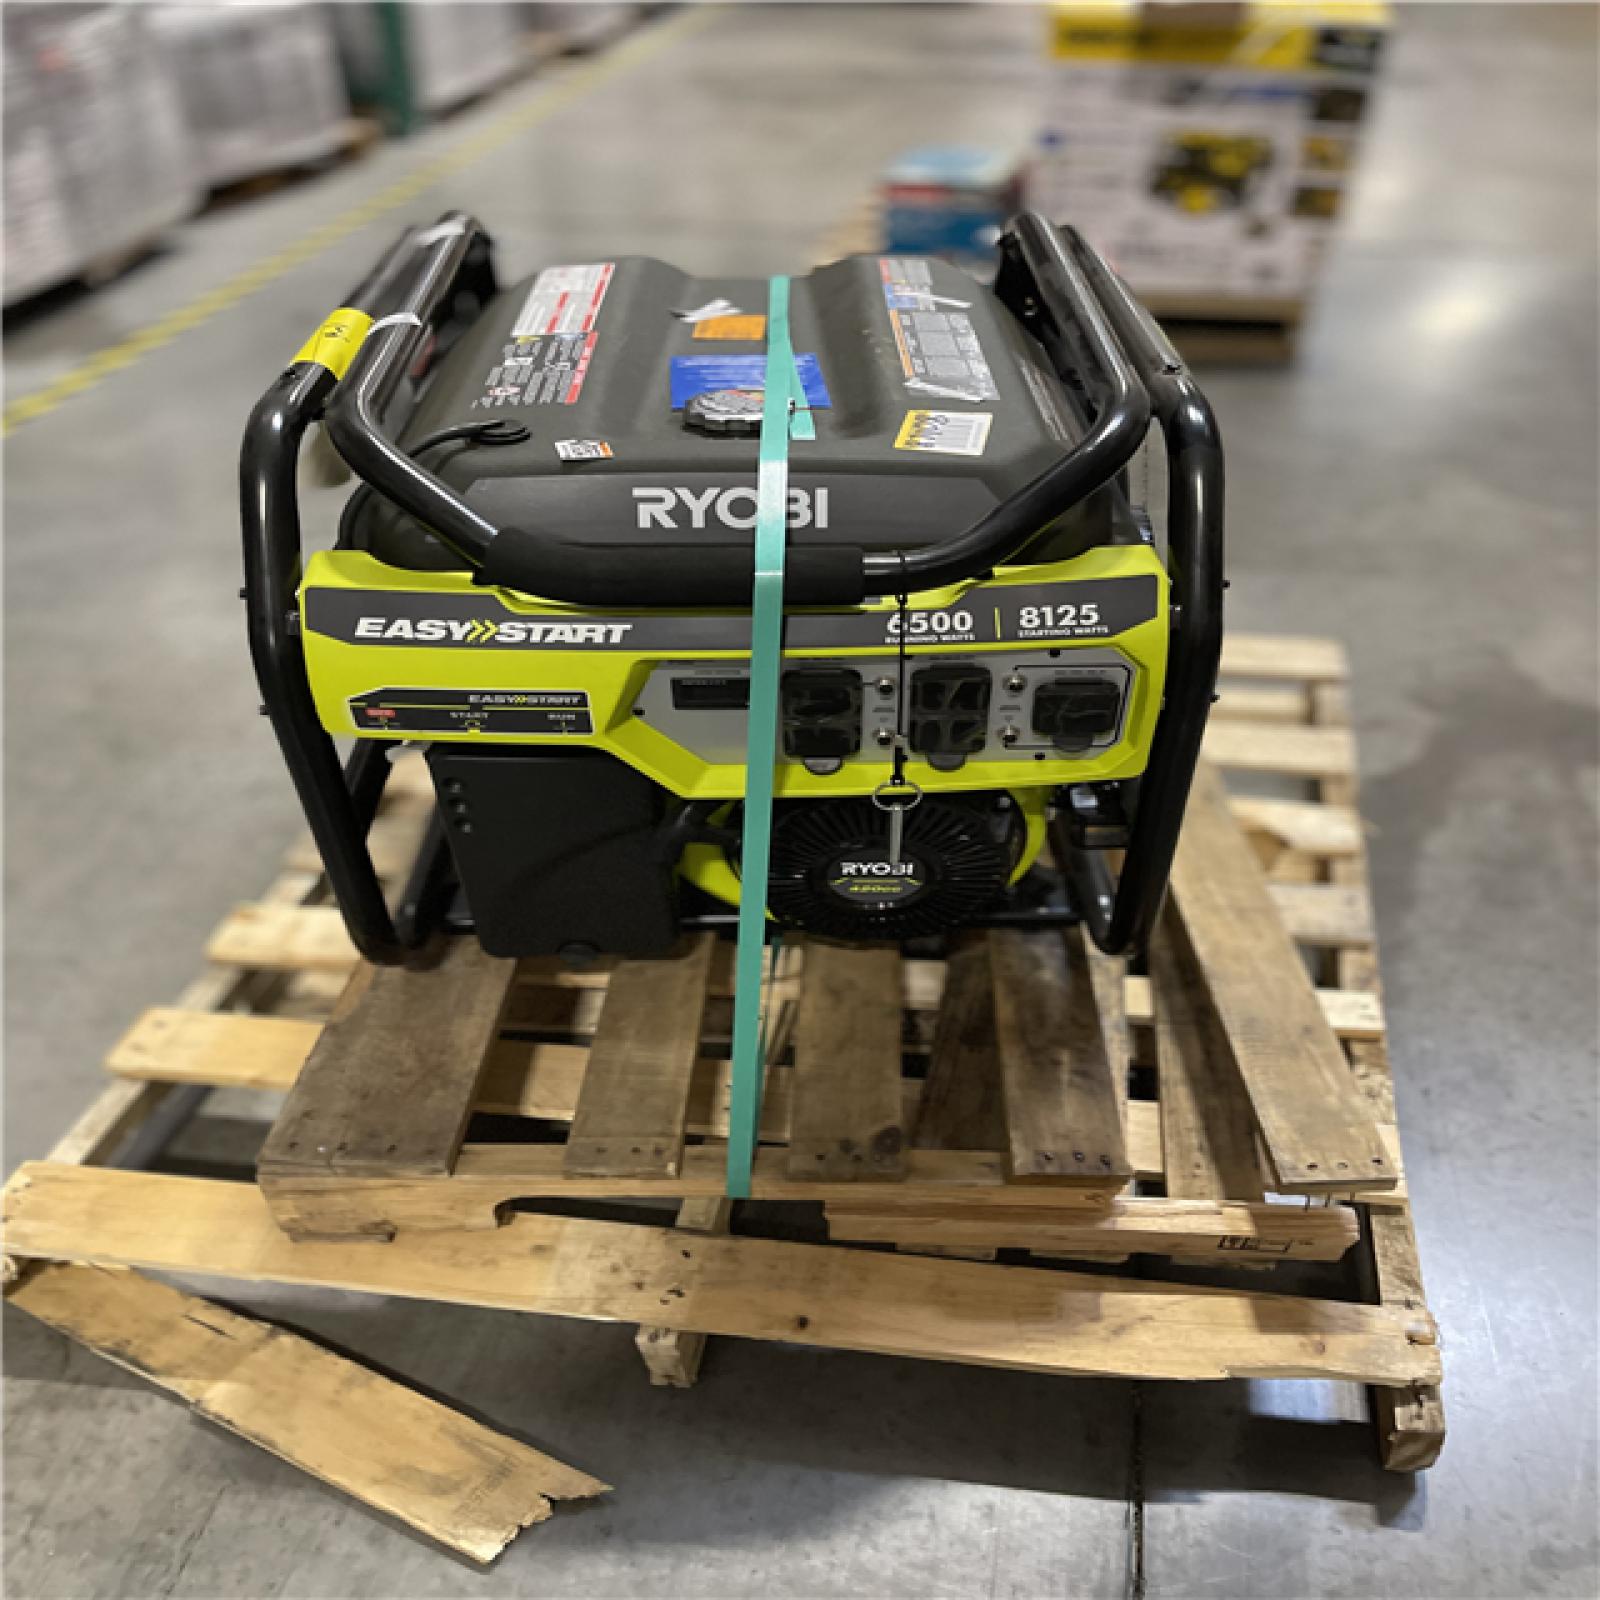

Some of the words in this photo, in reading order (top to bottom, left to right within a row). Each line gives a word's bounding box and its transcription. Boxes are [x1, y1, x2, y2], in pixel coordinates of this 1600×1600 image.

[632, 487, 829, 529] RYOBI
[886, 611, 975, 634] 6500
[1018, 604, 1100, 628] 8125
[354, 617, 472, 641] EASY
[494, 622, 633, 643] START
